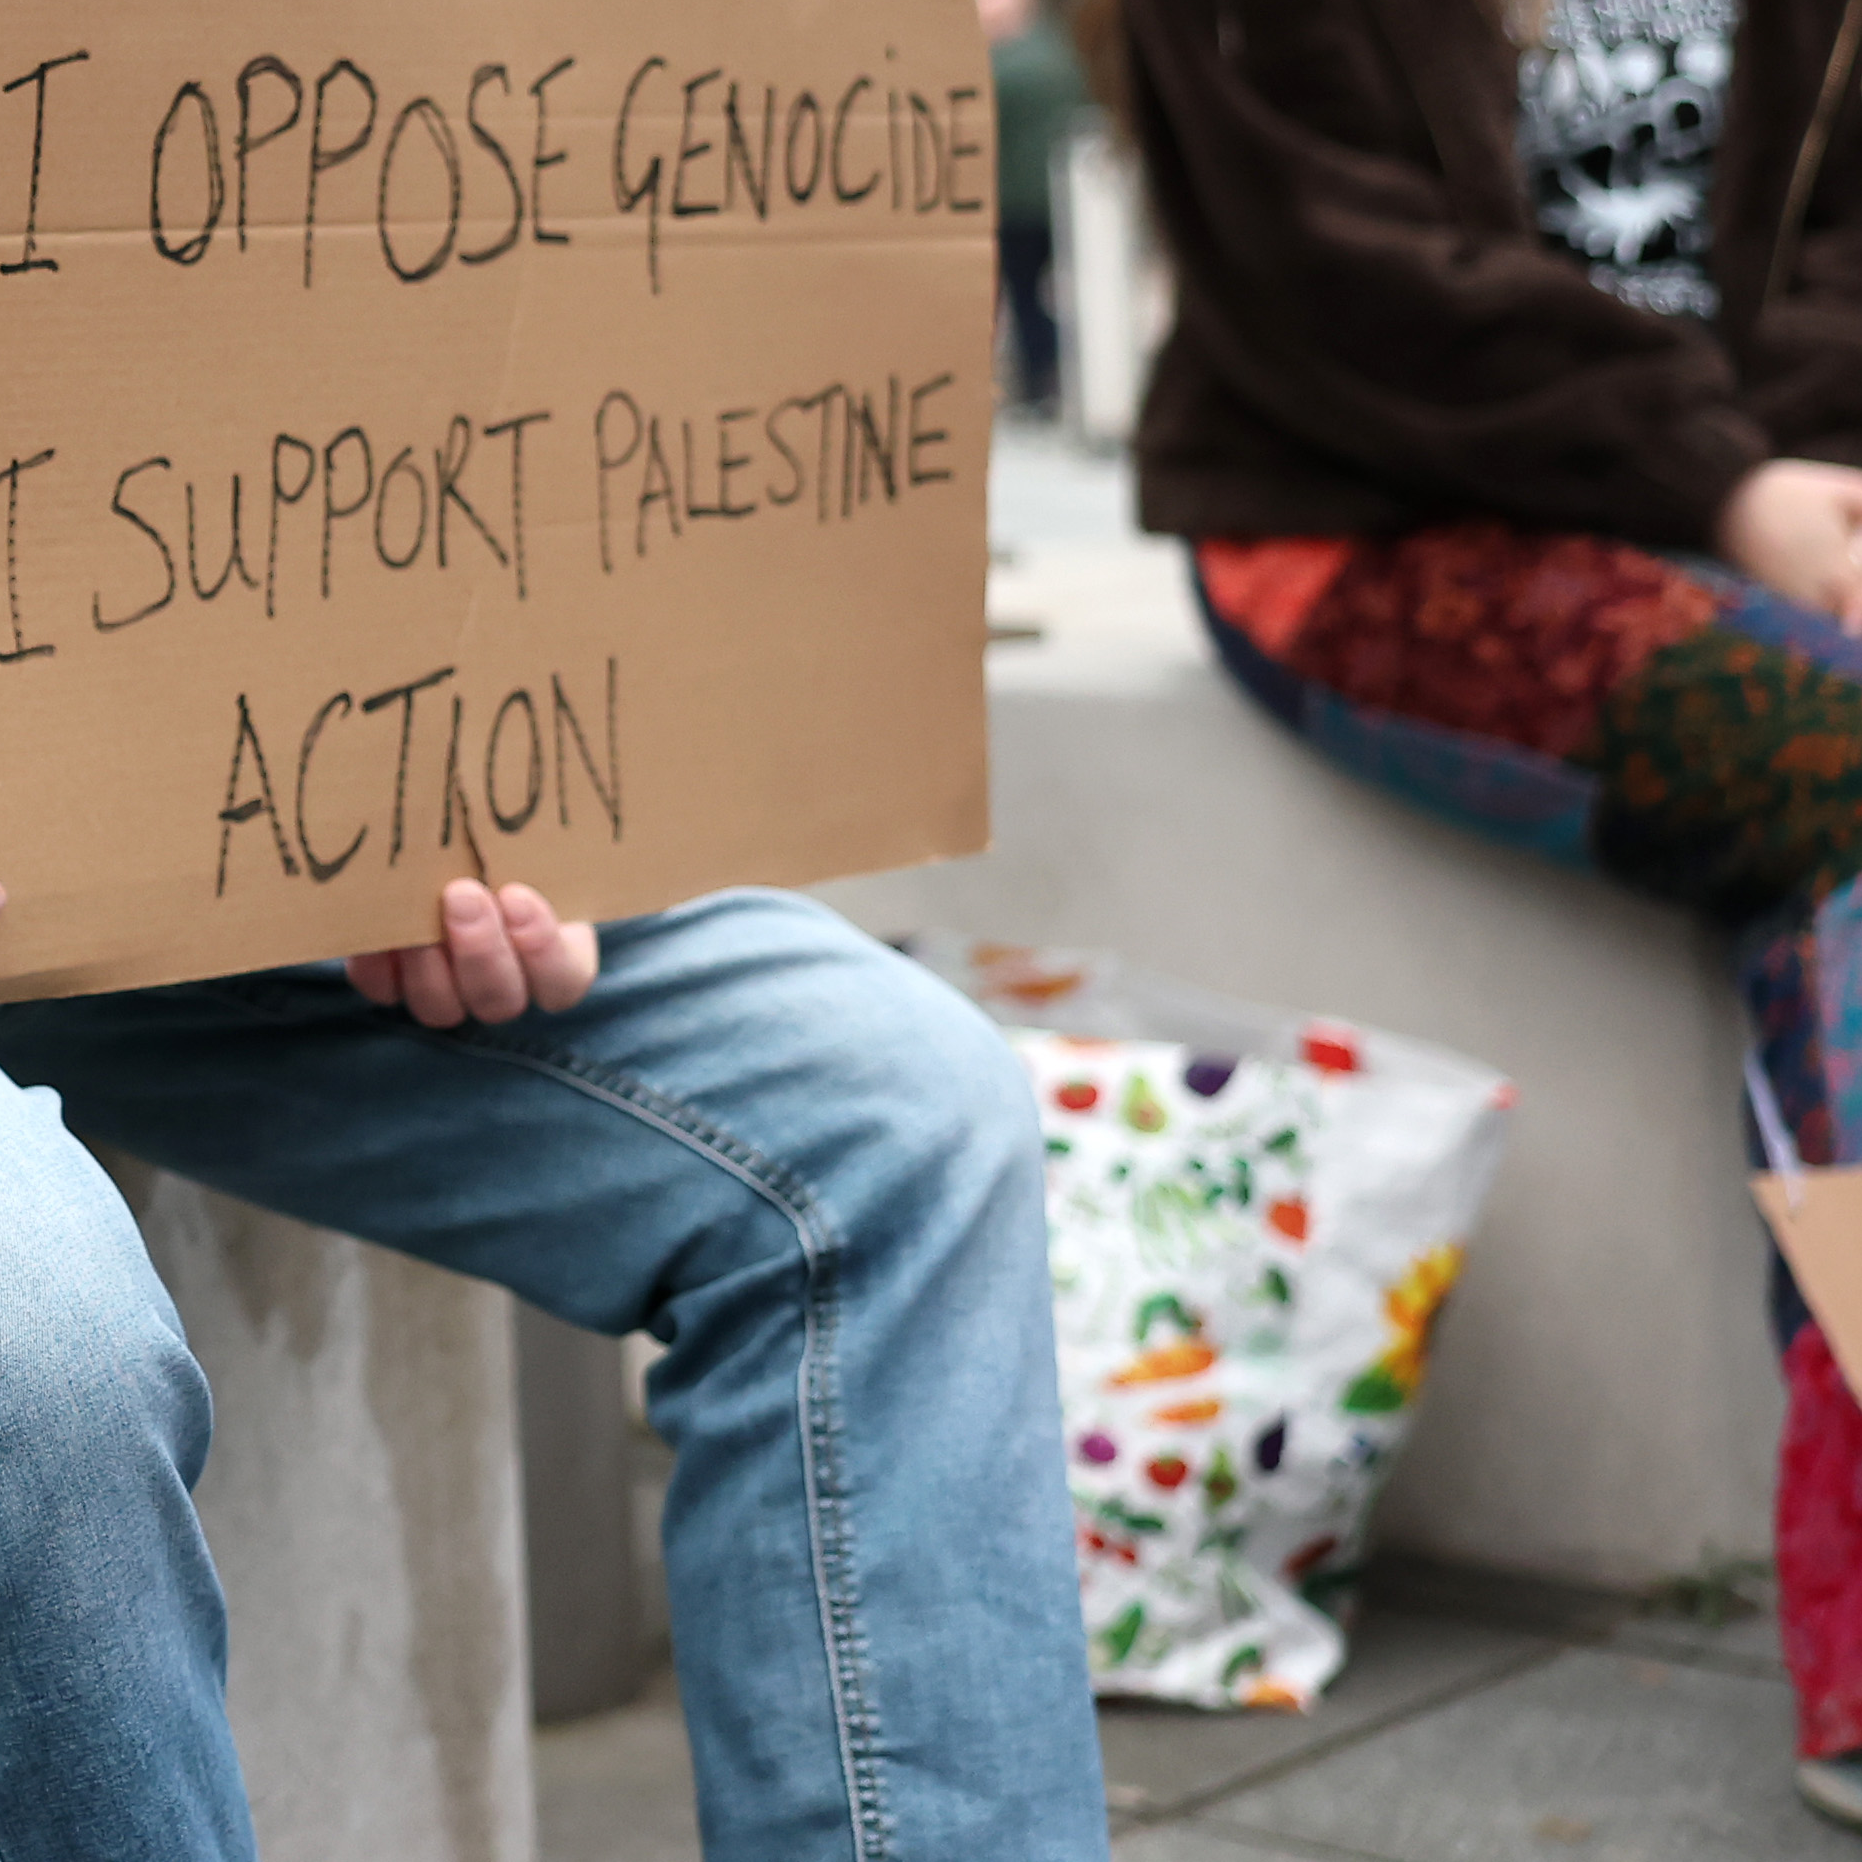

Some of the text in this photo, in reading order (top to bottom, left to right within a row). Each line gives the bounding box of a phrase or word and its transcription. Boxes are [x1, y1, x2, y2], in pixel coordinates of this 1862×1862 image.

[2, 50, 89, 275] I
[150, 55, 576, 289] OPPOSE
[92, 412, 550, 632] SUPPORT
[595, 374, 953, 575] PALESTINE
[216, 658, 623, 899] ACTION
